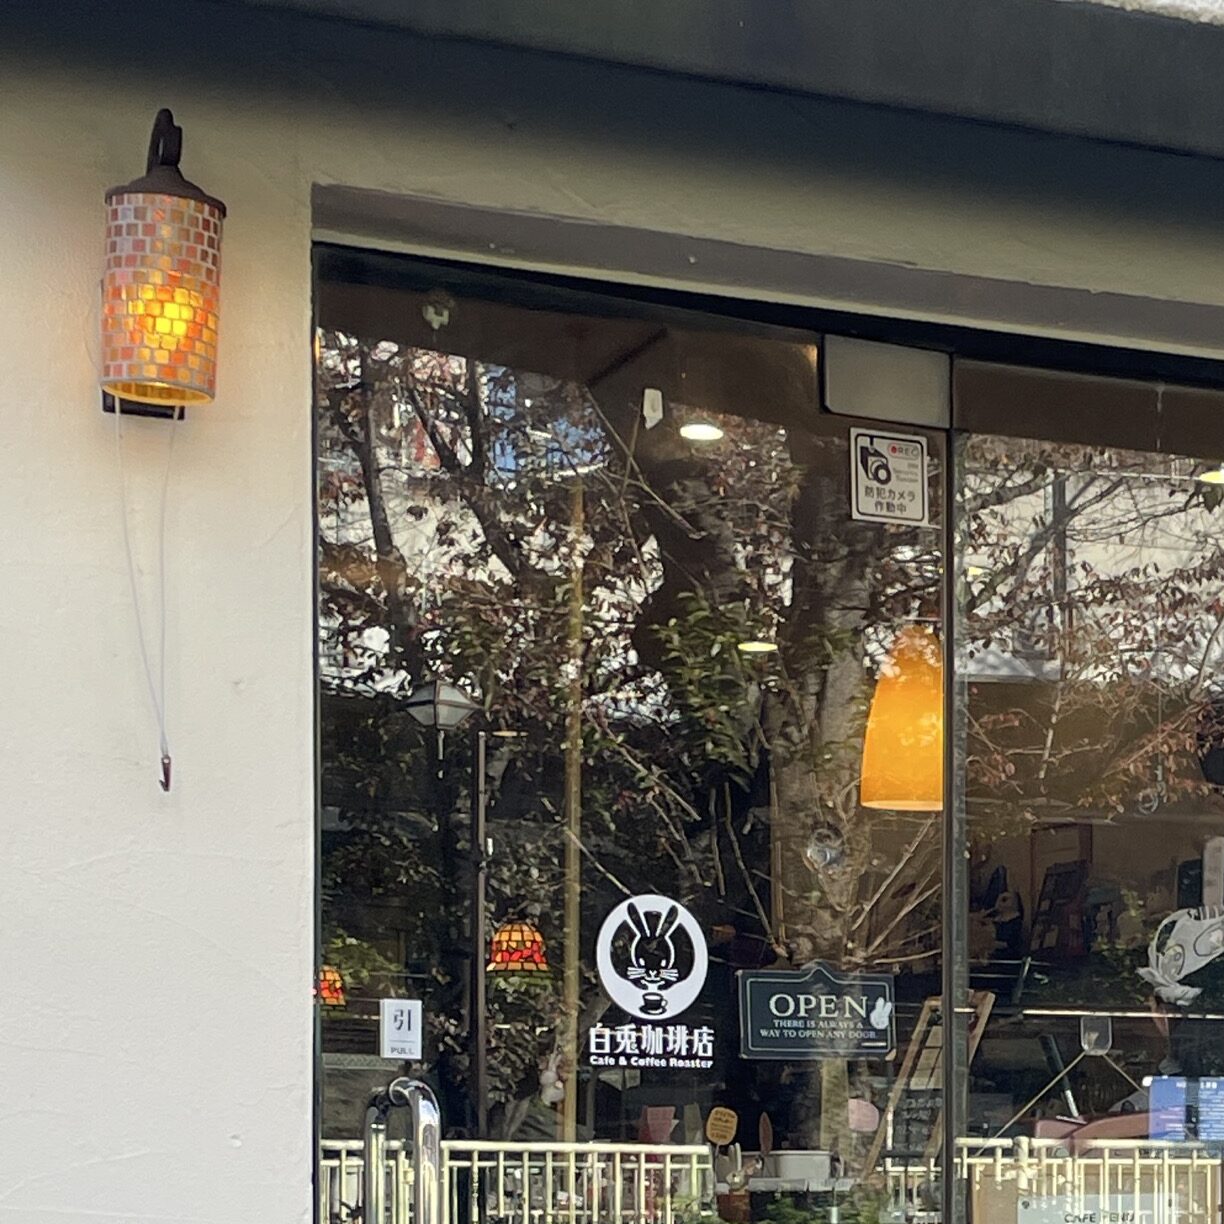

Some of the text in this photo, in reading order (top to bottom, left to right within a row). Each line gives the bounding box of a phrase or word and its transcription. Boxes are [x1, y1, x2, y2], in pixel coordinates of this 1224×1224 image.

[864, 486, 916, 502] 防犯カメラ
[874, 500, 907, 514] 作動中
[769, 993, 868, 1018] OPEN
[393, 1009, 412, 1031] 引
[773, 1020, 804, 1028] THERE
[807, 1020, 815, 1028] IS
[818, 1020, 854, 1028] ALWAYS
[760, 1029, 780, 1037] WAY
[590, 1055, 713, 1068] Cafe & Coffee Roaster
